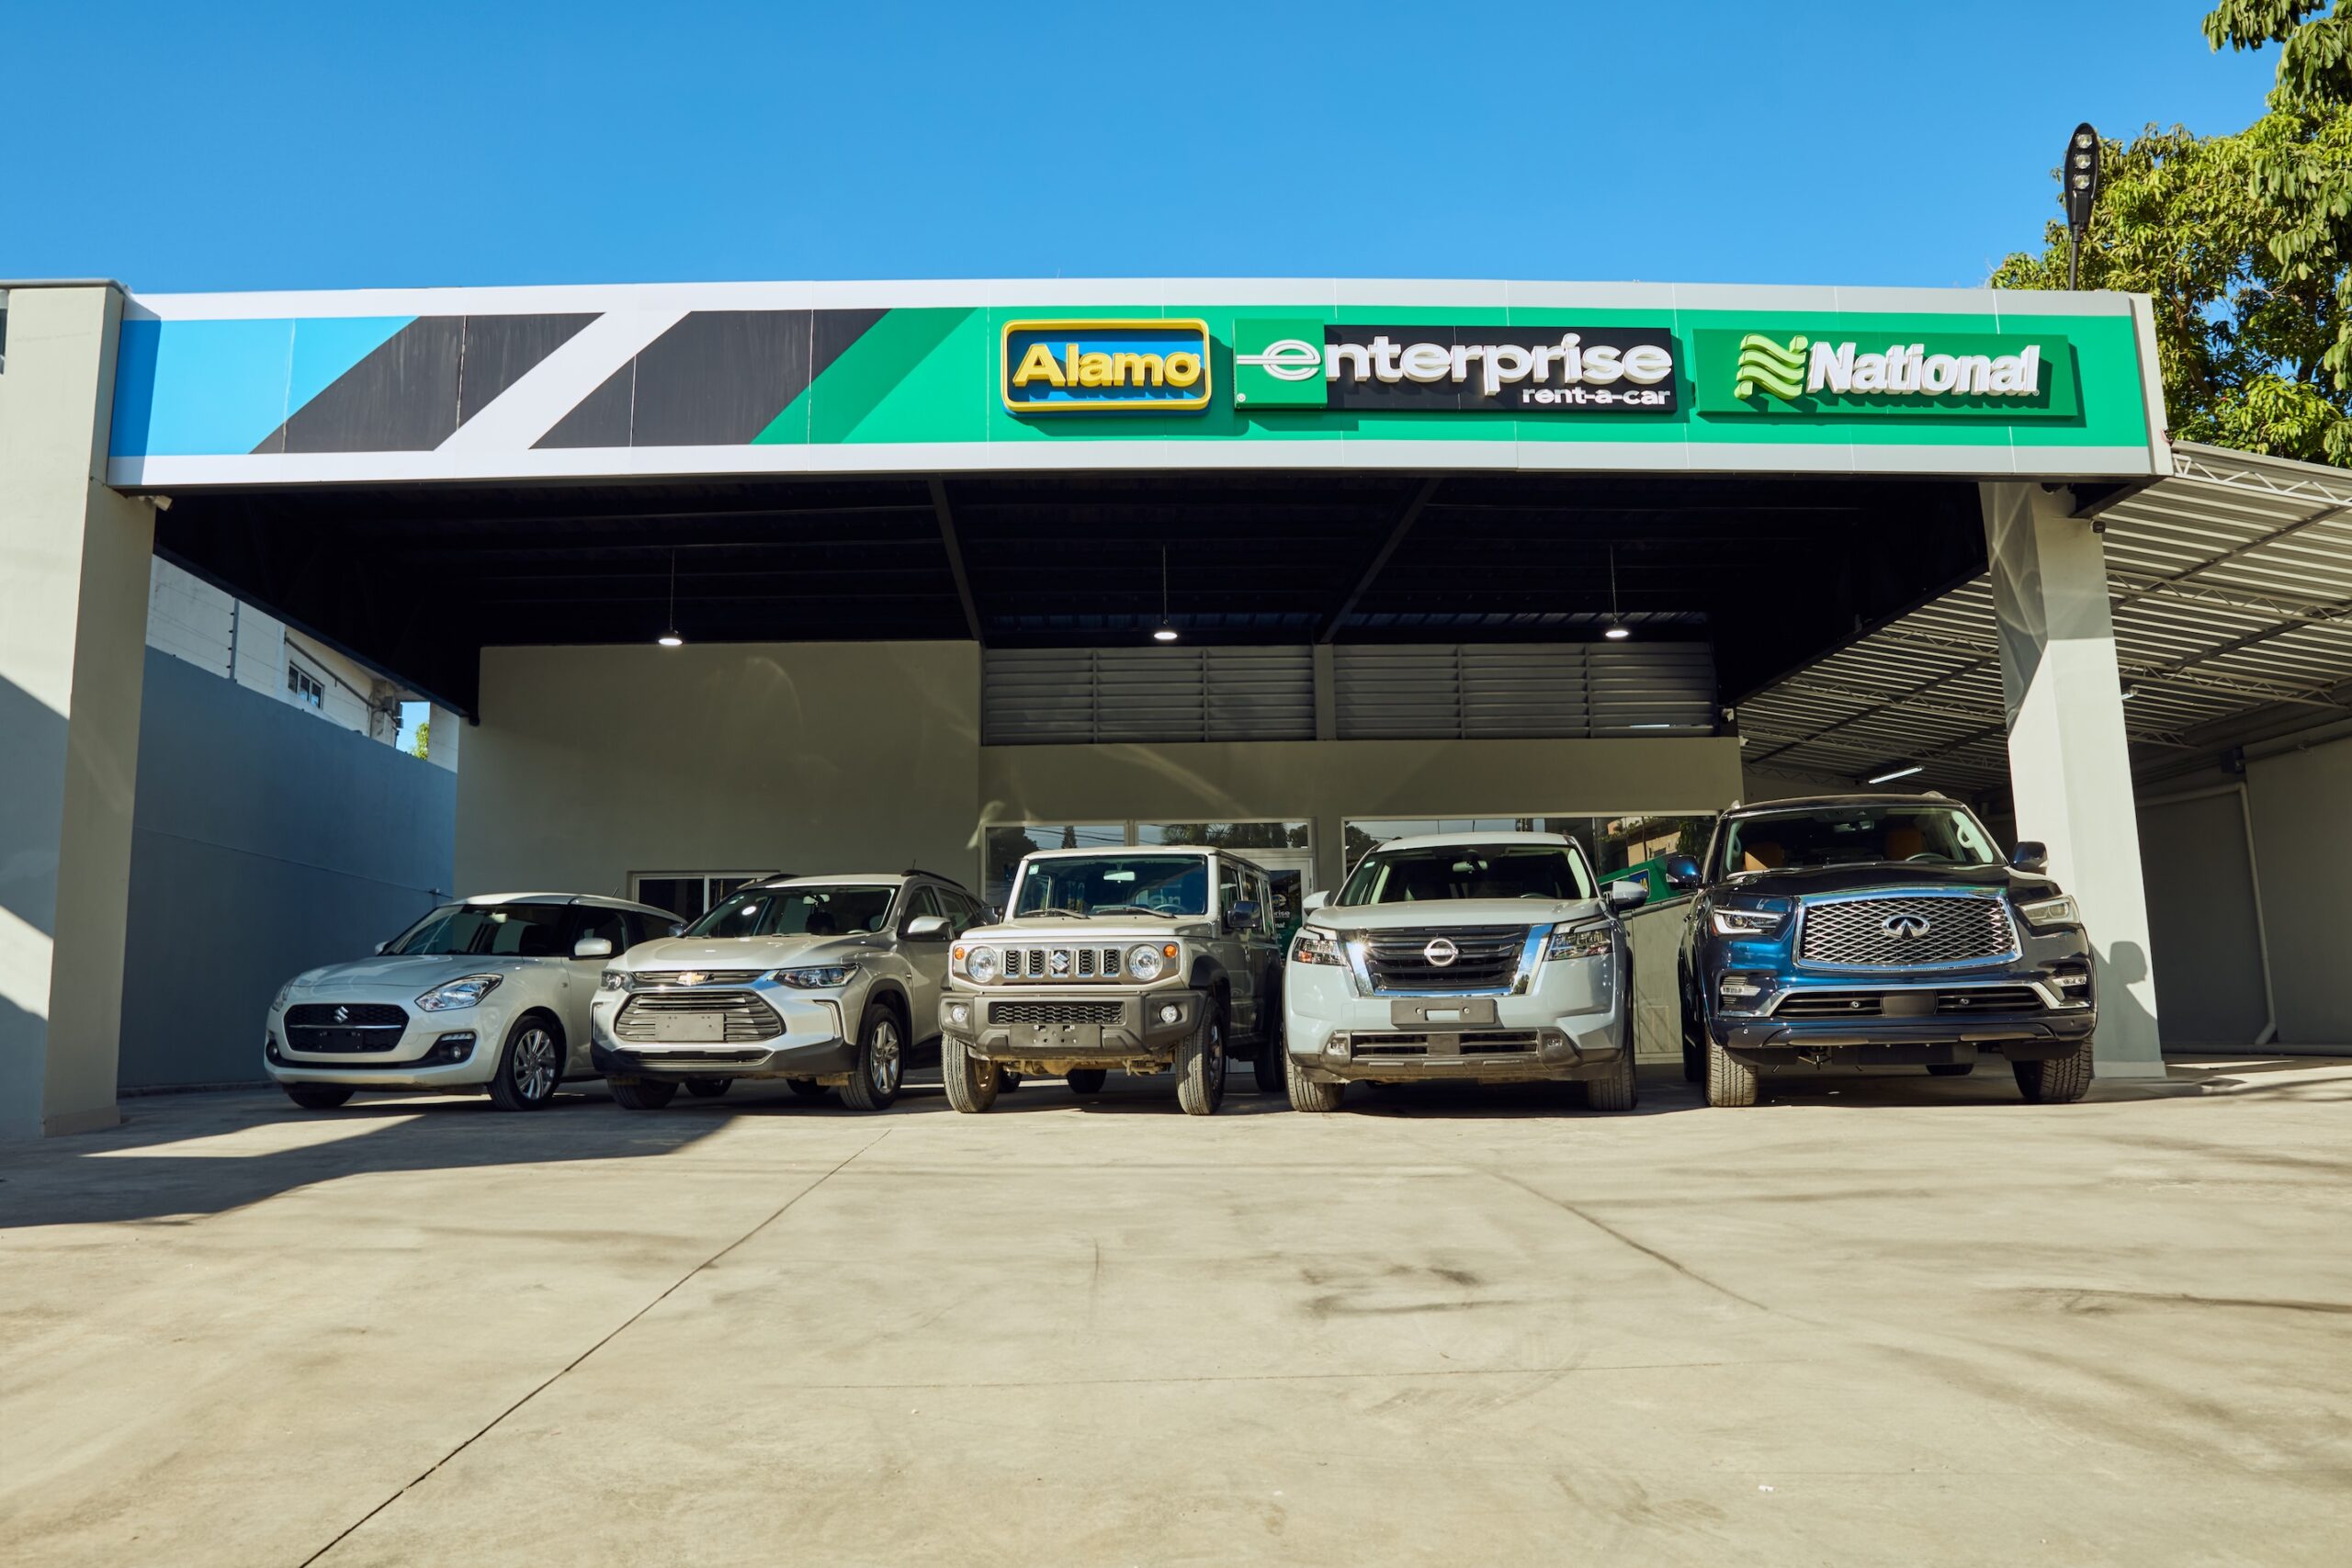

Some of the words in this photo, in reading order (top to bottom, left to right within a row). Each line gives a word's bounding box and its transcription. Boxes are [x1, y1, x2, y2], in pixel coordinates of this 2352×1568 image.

[1012, 343, 1201, 388] Alamo
[1236, 332, 1673, 397] enterprise
[1806, 341, 2041, 397] National
[1521, 386, 1671, 405] rent-a-car
